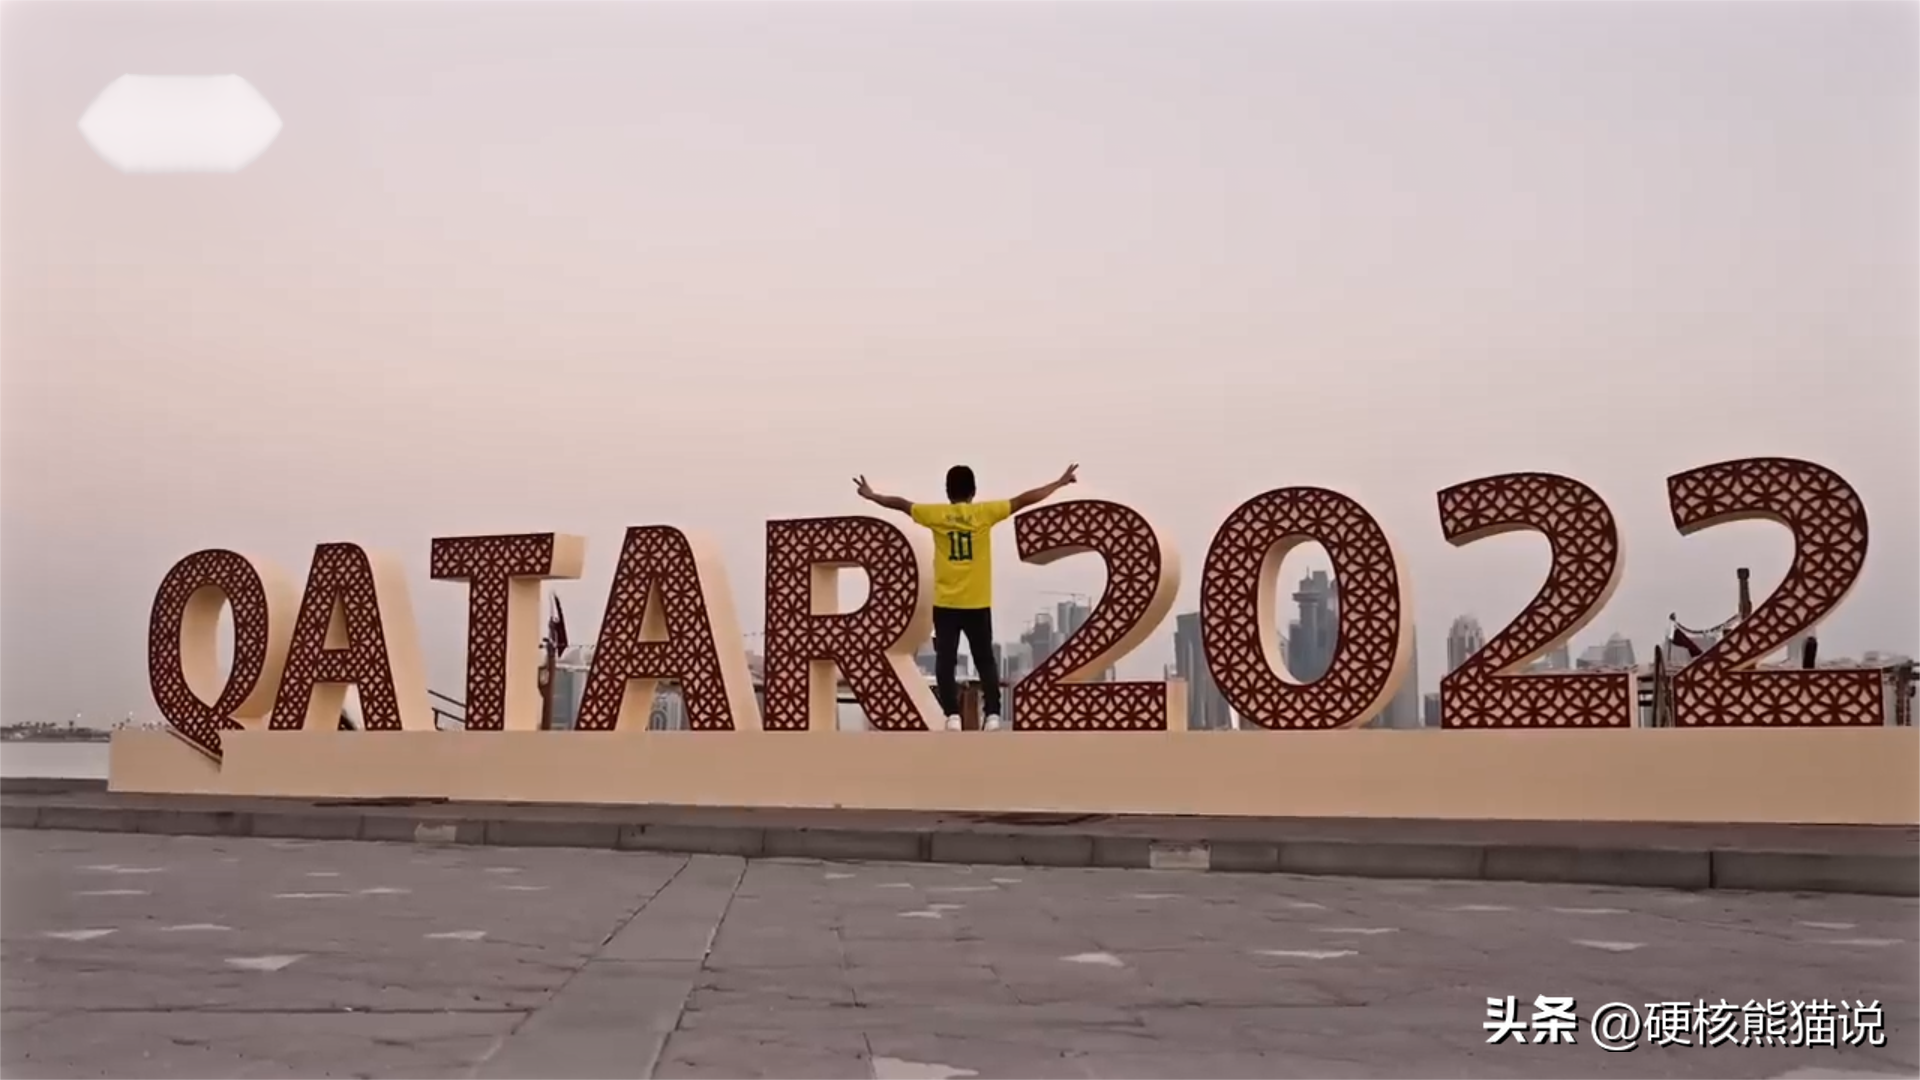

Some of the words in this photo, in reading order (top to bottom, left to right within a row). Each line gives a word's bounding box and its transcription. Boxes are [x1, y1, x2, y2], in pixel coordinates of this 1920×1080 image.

[148, 514, 930, 762] QATAR
[1012, 456, 1884, 730] 2022
[948, 531, 972, 561] 10
